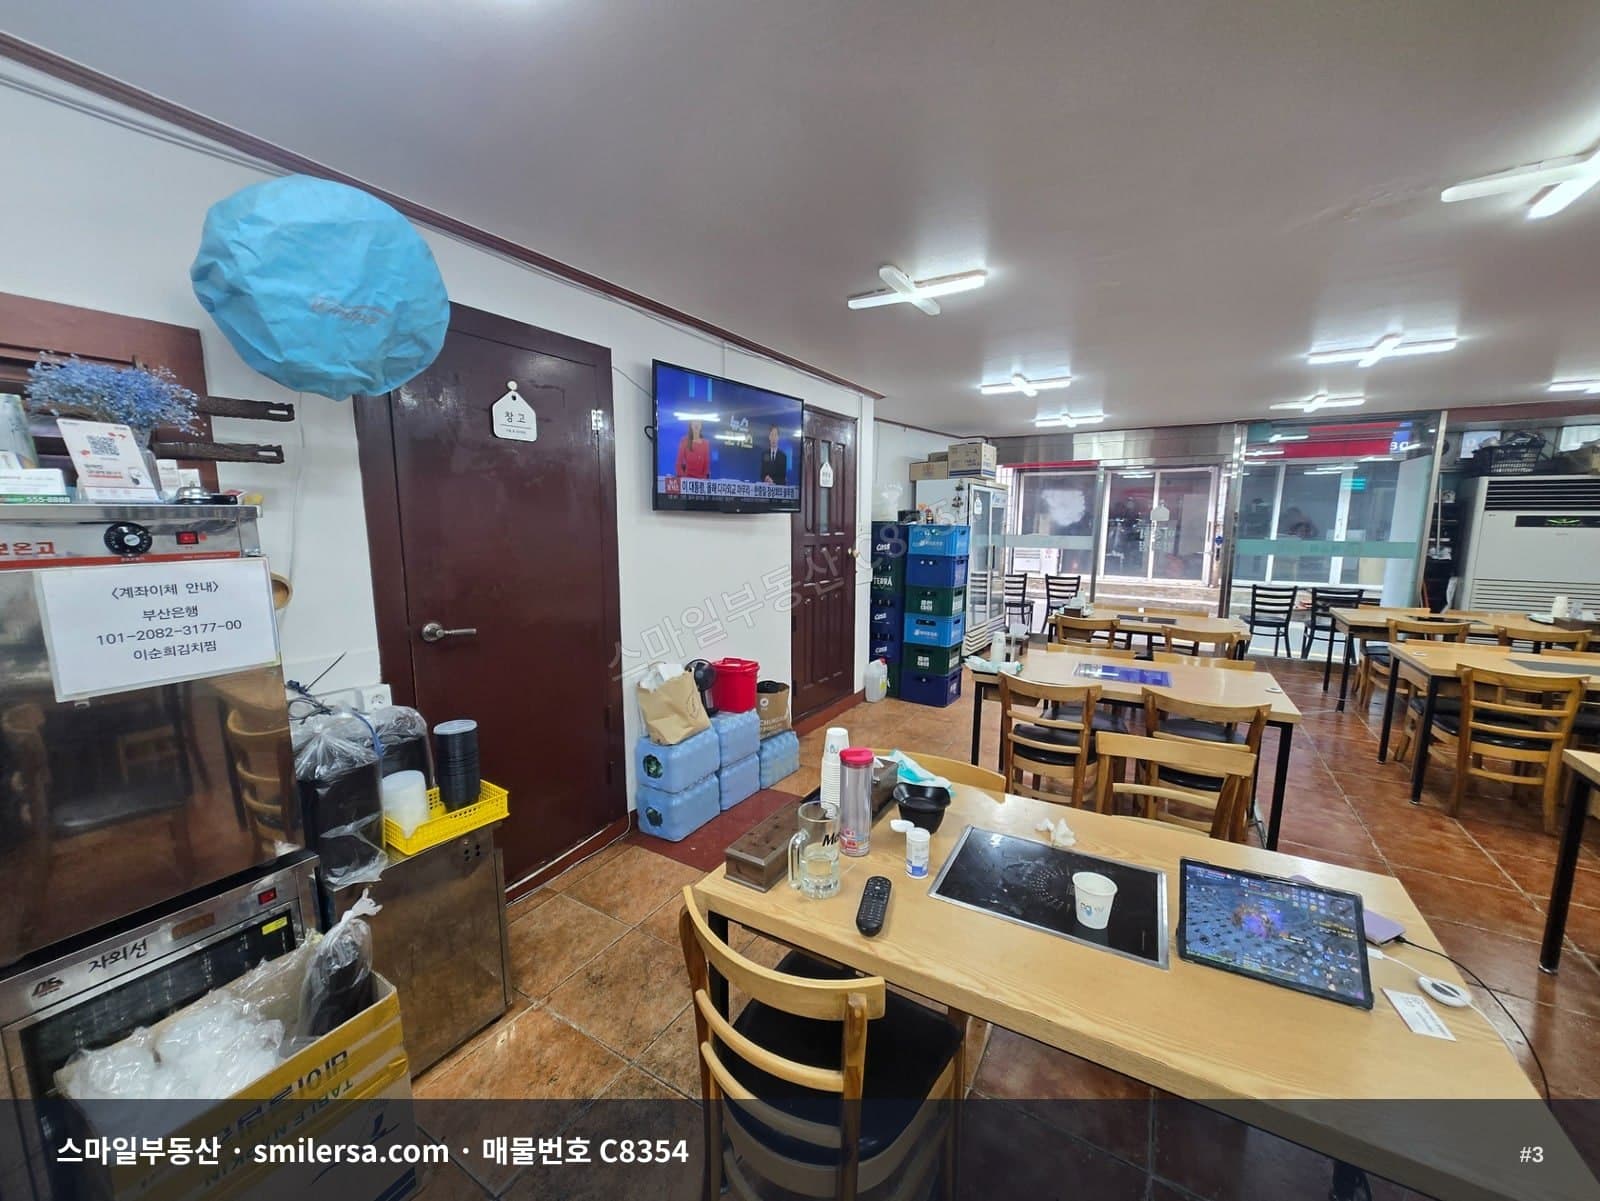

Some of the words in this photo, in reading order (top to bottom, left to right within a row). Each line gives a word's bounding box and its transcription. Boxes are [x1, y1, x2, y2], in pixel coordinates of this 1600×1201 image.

[505, 411, 526, 424] 창고
[142, 605, 199, 621] 부산은행
[96, 619, 242, 646] 101-2082-3177-00
[133, 640, 217, 661] 이순희김치찜
[88, 938, 148, 973] 자외선
